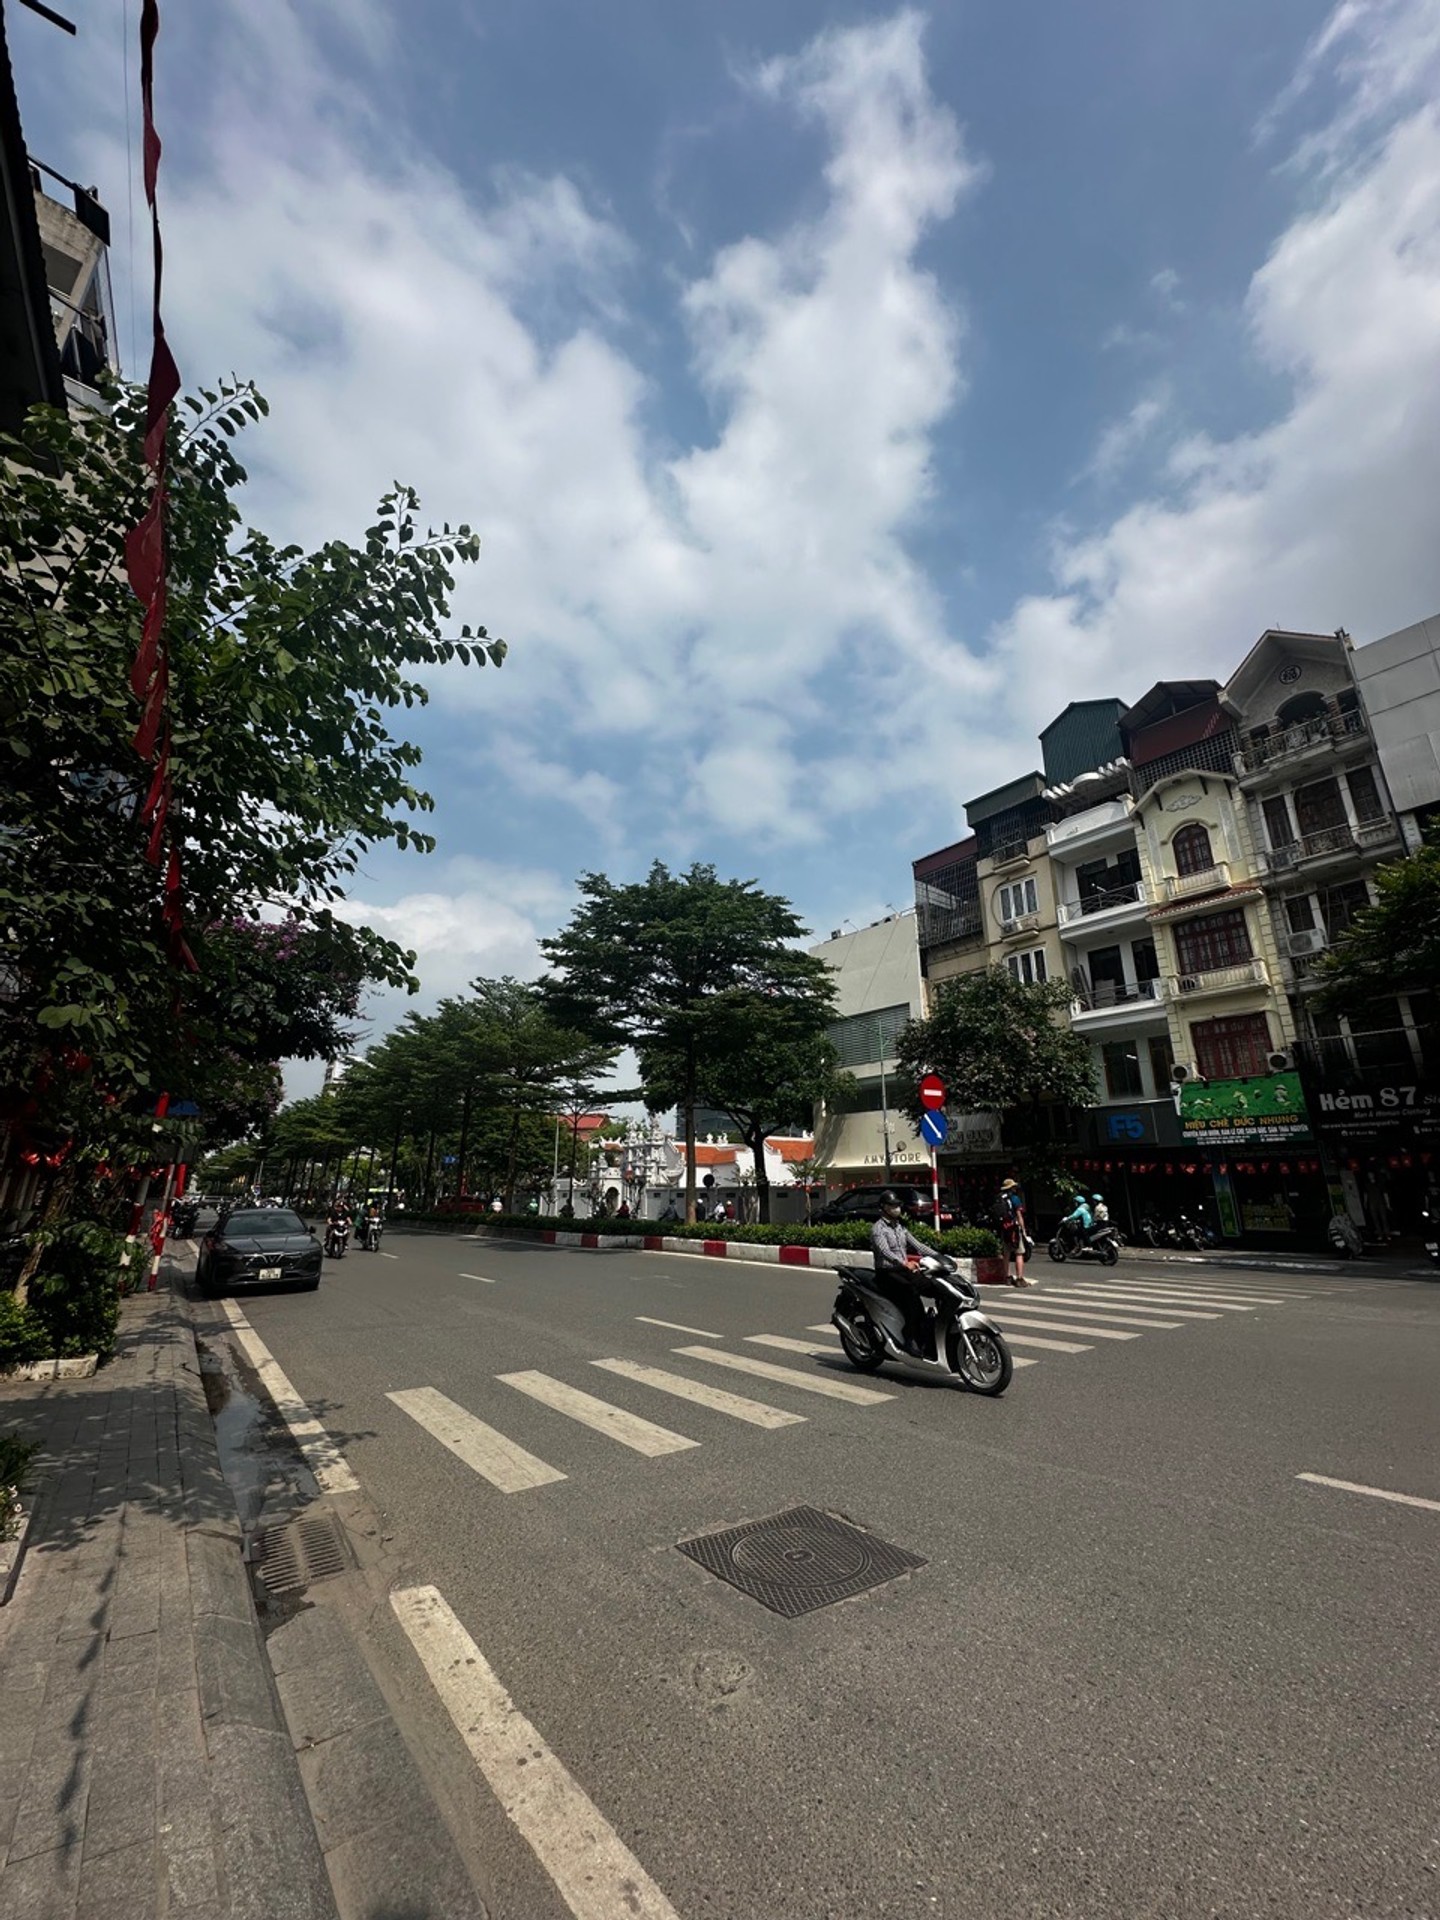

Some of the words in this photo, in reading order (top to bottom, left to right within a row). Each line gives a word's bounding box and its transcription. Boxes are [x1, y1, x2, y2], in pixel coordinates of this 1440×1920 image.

[1319, 1089, 1374, 1111] Hẻm
[1380, 1086, 1416, 1107] 87
[1108, 1114, 1145, 1140] F5
[1259, 1114, 1299, 1125] NHUNG
[864, 1154, 885, 1165] AMY
[886, 1152, 922, 1164] TORE
